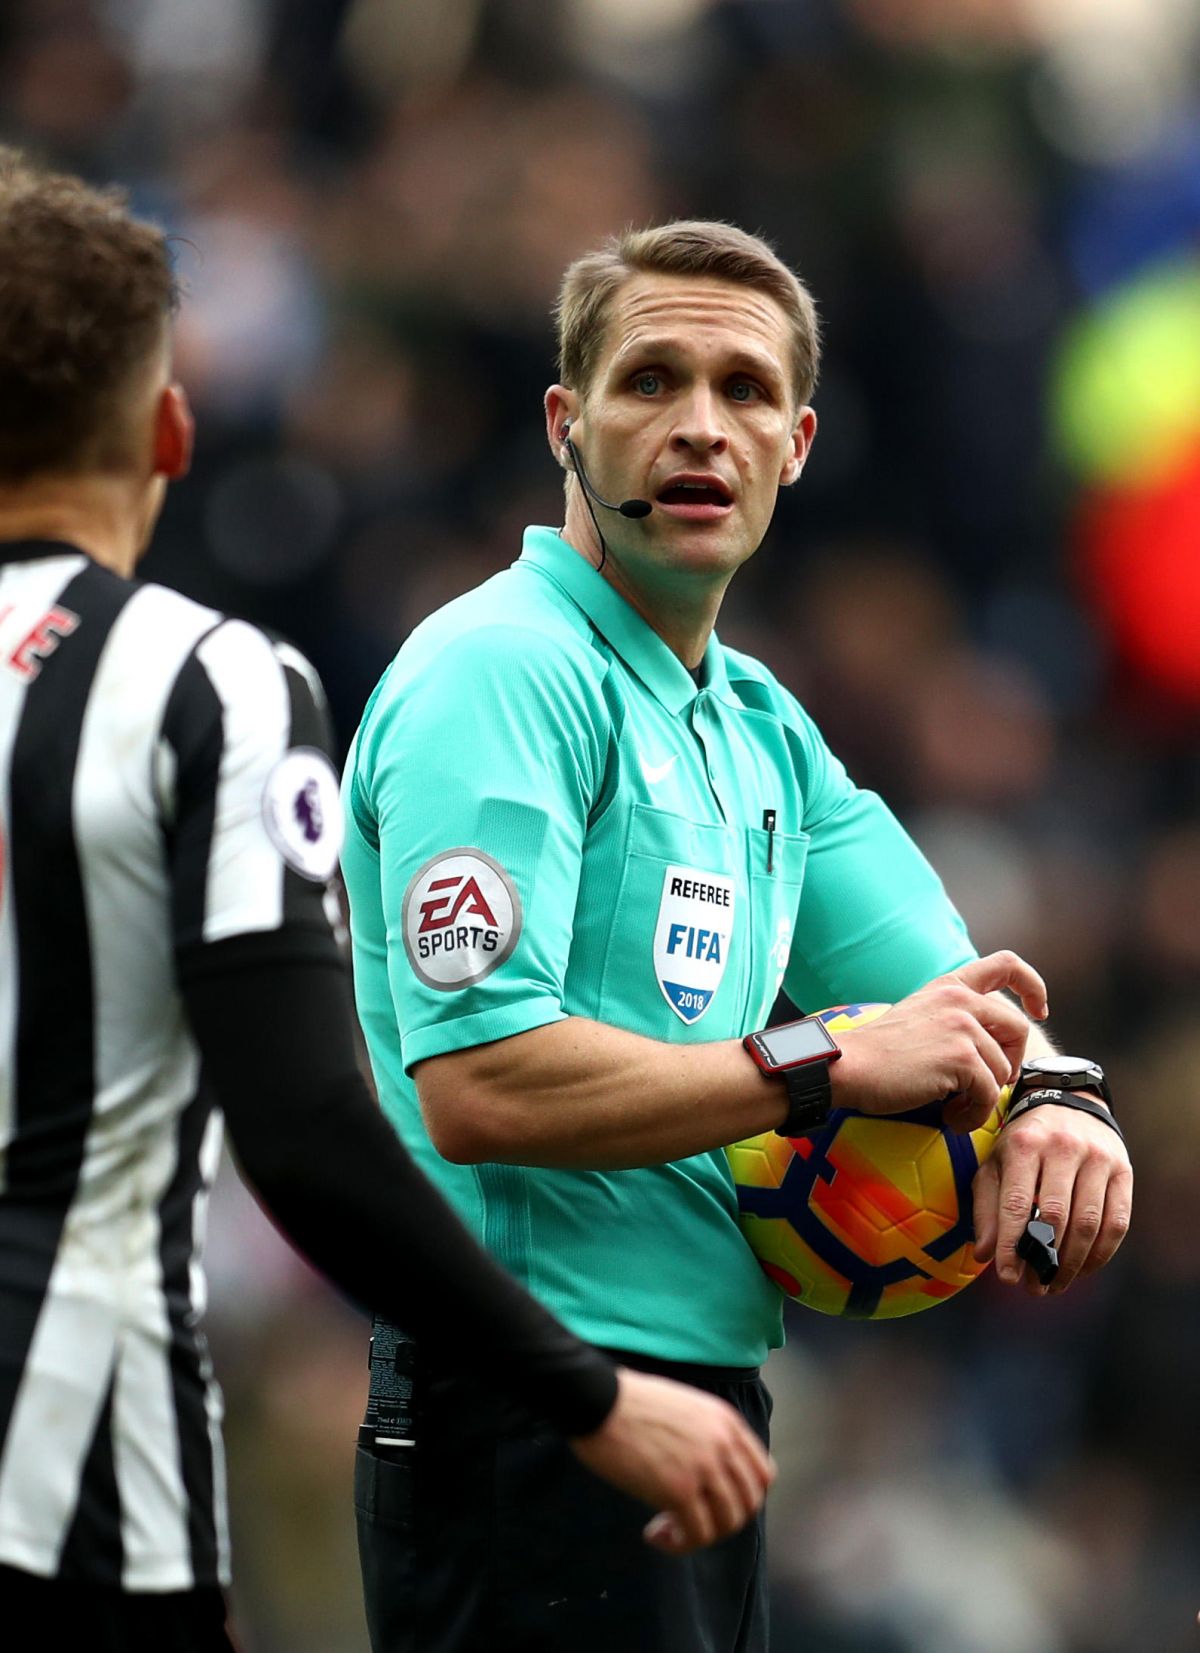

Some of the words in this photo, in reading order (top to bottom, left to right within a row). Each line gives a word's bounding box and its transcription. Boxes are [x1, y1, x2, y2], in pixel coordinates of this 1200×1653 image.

[418, 875, 499, 934] EA
[670, 877, 731, 908] REFEREE
[418, 926, 499, 959] SPORTS
[666, 923, 722, 964] FIFA
[677, 991, 705, 1011] 2018
